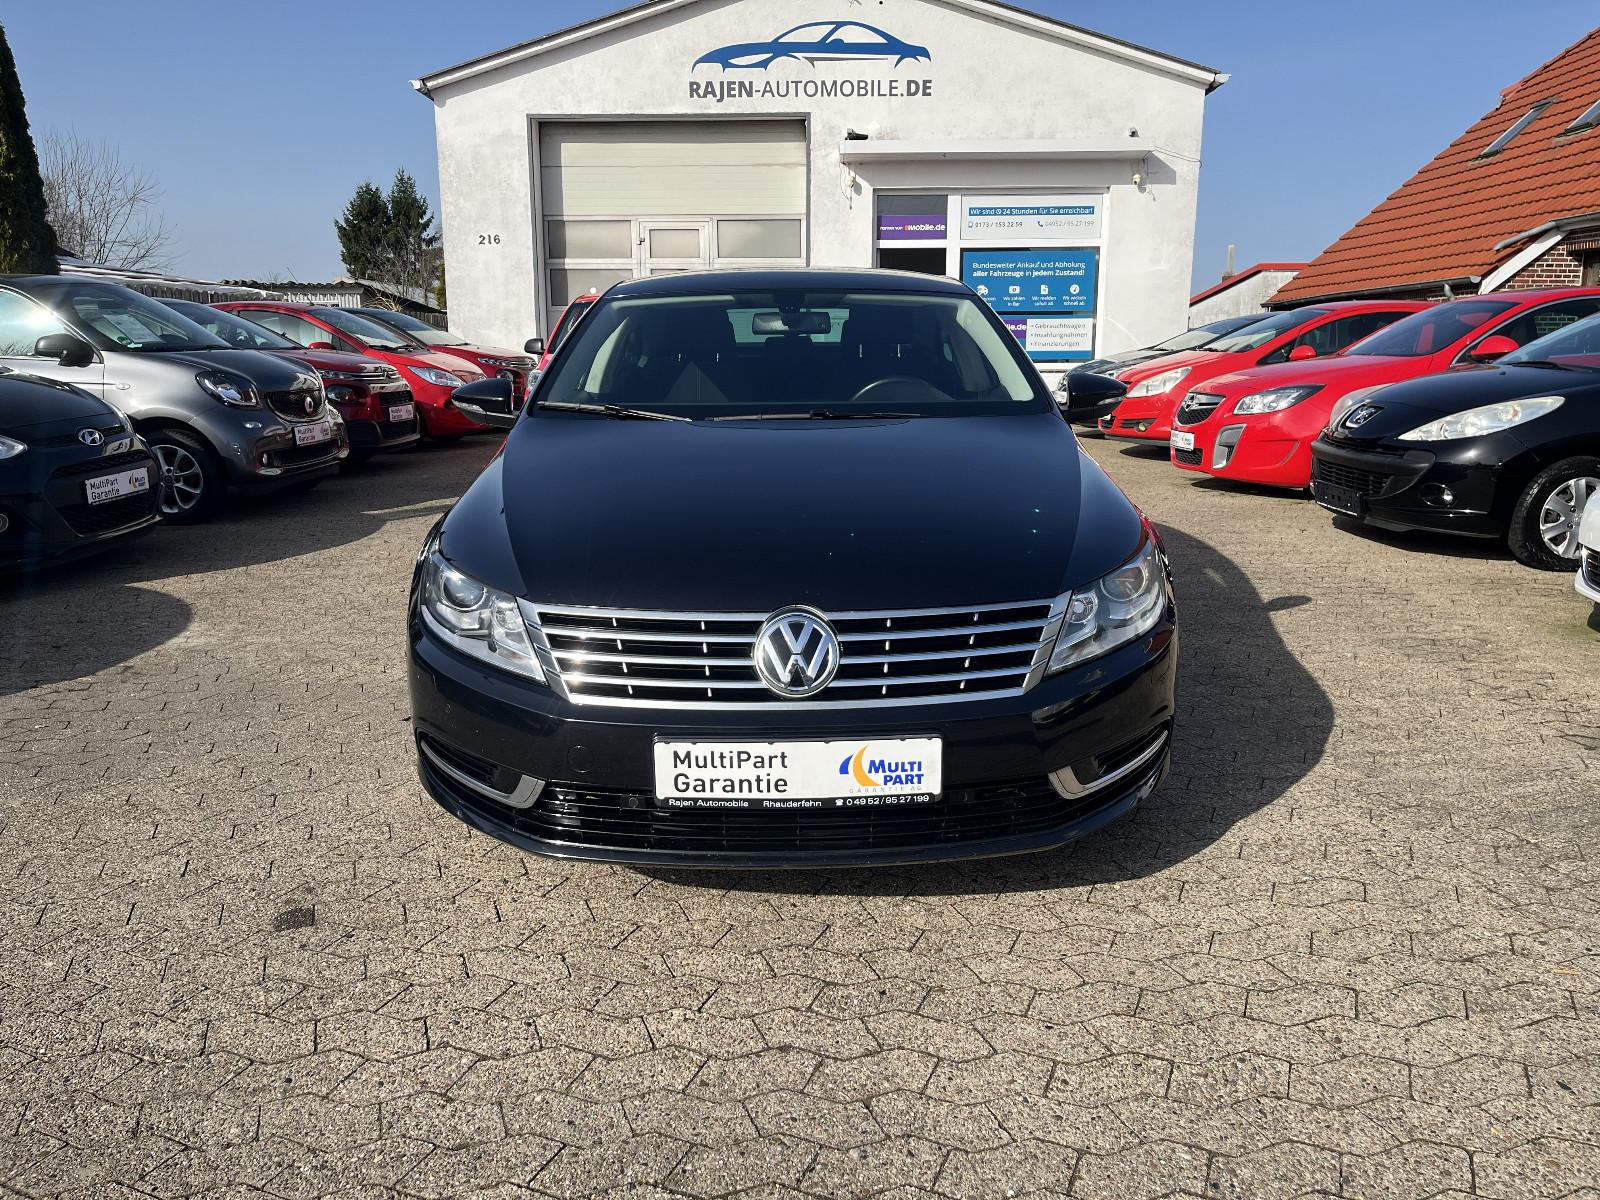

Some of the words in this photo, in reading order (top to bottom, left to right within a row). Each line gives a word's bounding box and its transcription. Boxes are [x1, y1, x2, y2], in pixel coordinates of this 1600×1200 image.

[688, 79, 933, 102] RAJEN-AUTOMOBILE.DE
[1059, 206, 1093, 214] erreichbar!
[478, 234, 501, 245] 216
[972, 261, 1015, 269] Bundesweiter
[1016, 261, 1040, 269] Ankauf
[1055, 261, 1086, 270] Abholung
[989, 270, 1024, 278] Fahrzeuge
[1032, 269, 1054, 277] jedem
[89, 478, 119, 491] MultiPart
[91, 488, 120, 501] Garantie
[672, 750, 788, 769] MultiPart
[867, 758, 923, 774] MULTI
[672, 772, 789, 793] Garantie
[882, 773, 925, 786] PART
[848, 786, 905, 794] GARANTIE
[668, 798, 694, 808] Rajen
[696, 798, 749, 808] Automobile
[762, 799, 822, 808] Rhauderfehn
